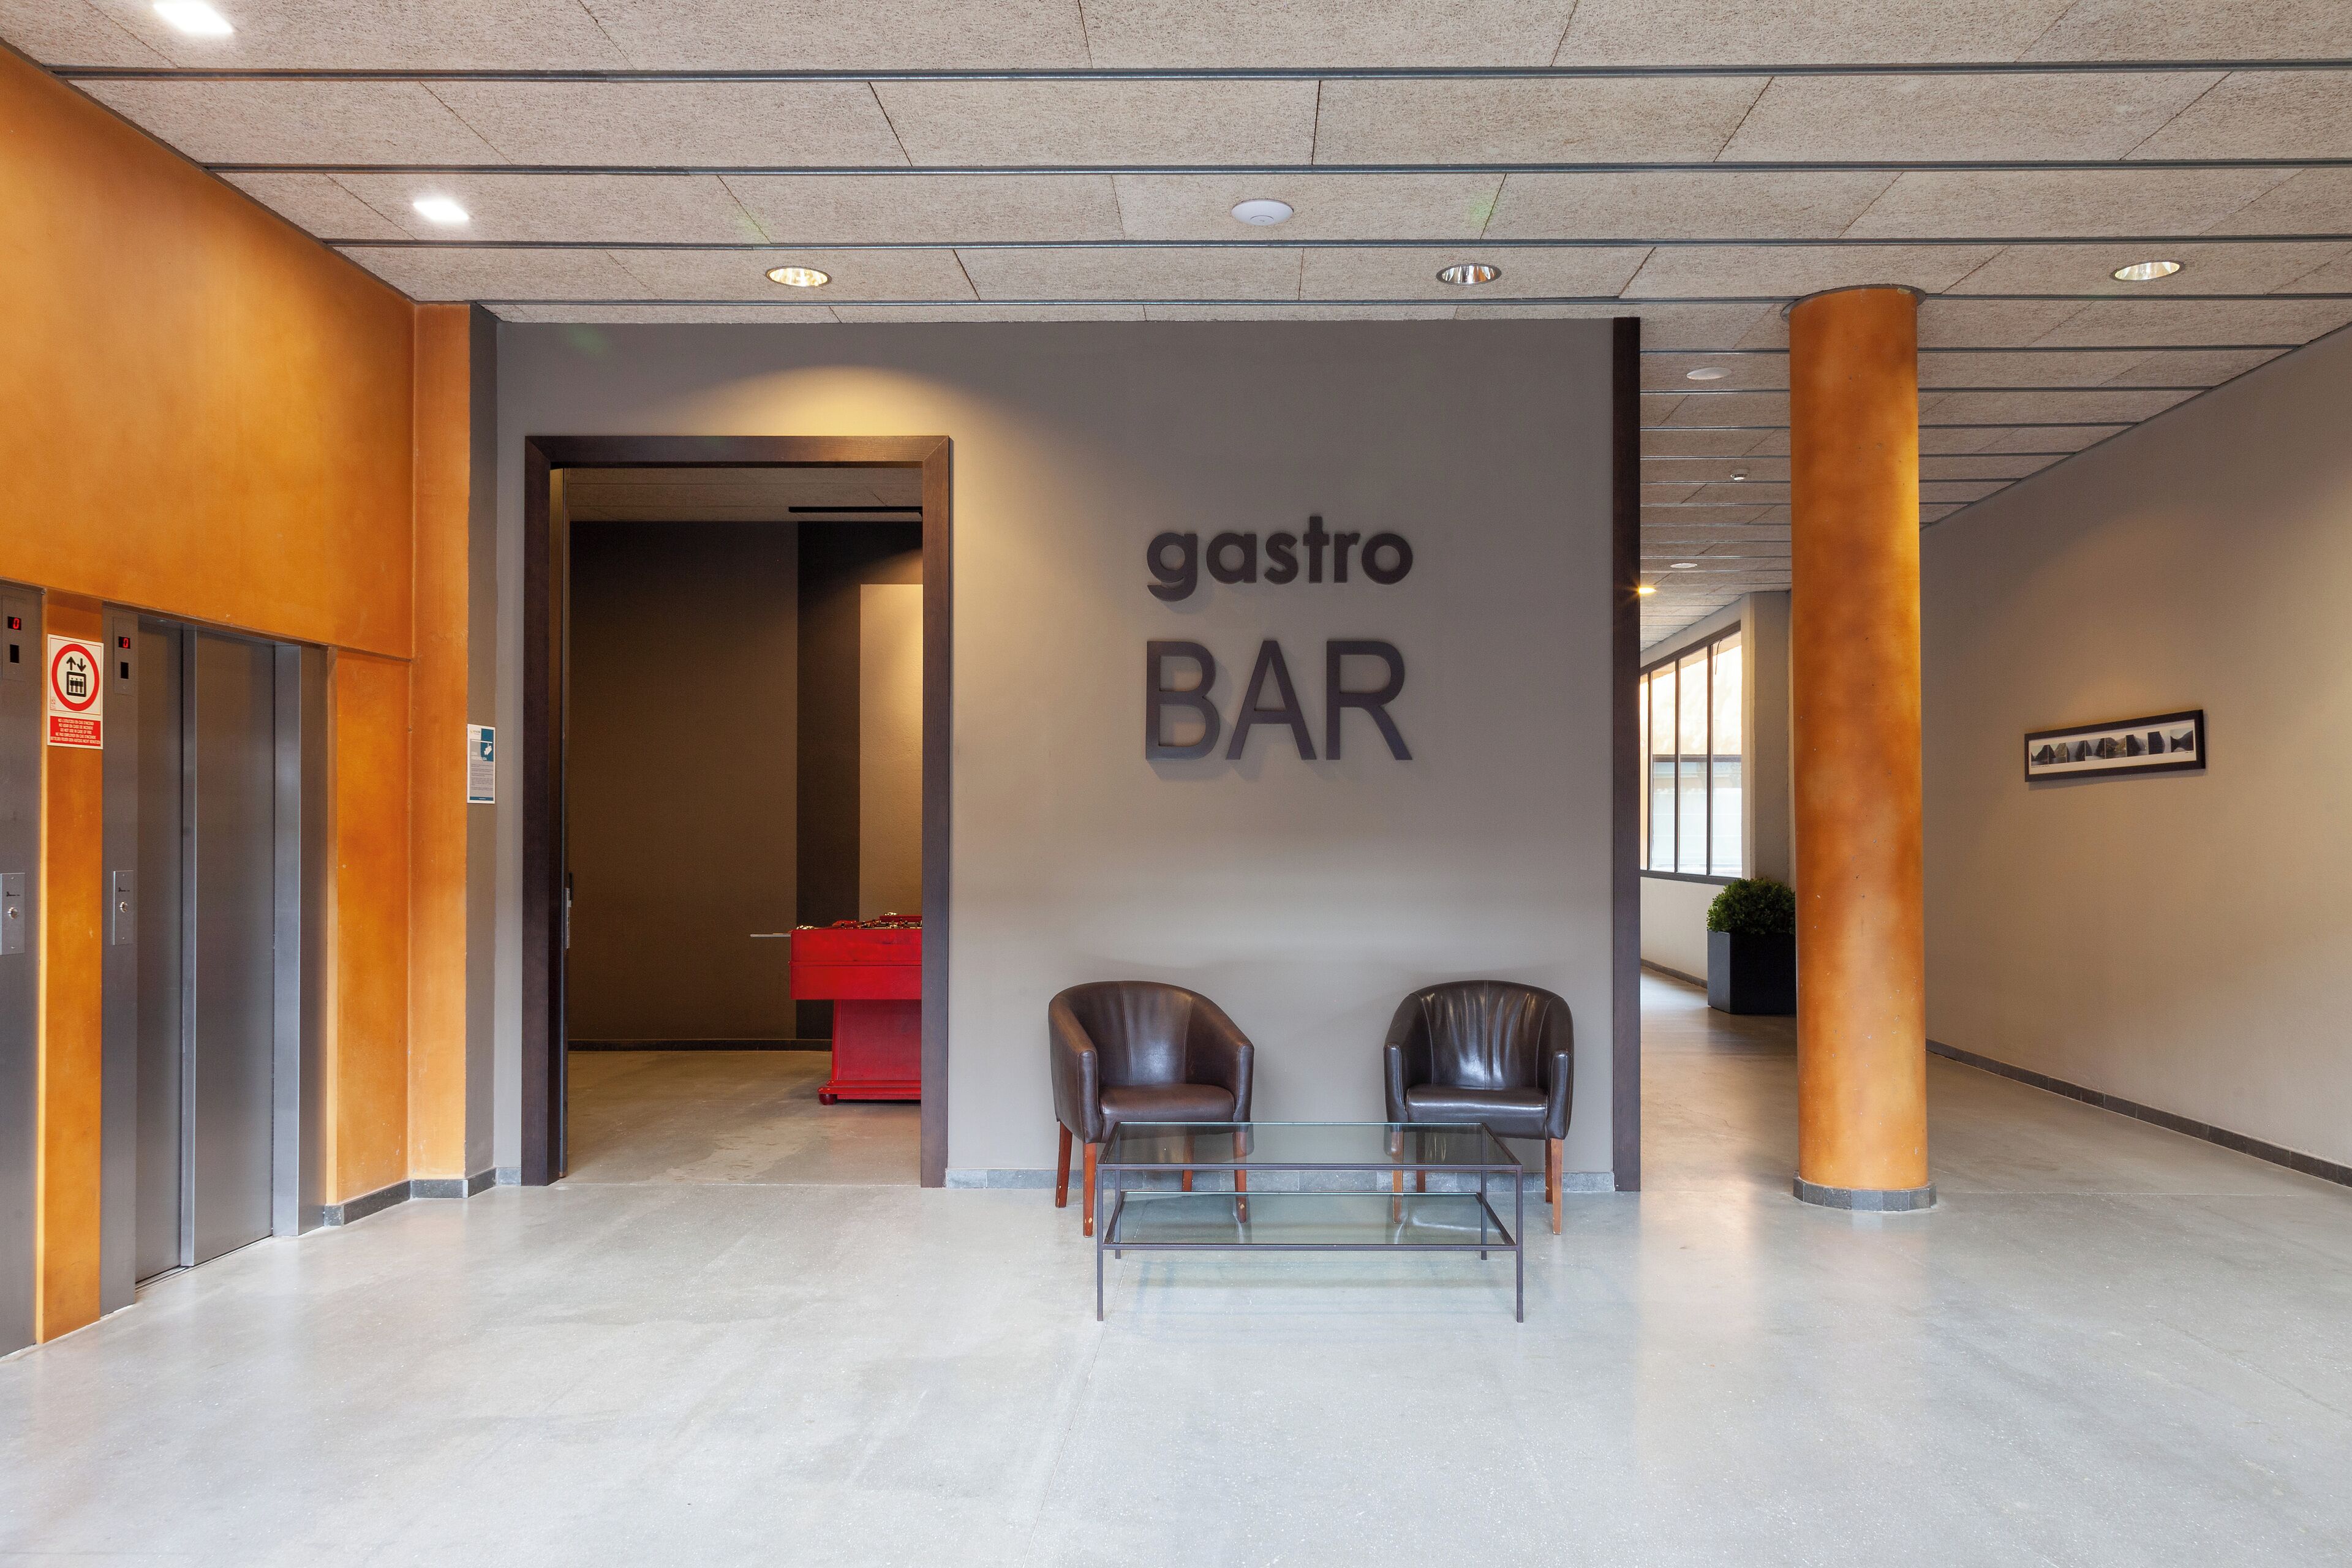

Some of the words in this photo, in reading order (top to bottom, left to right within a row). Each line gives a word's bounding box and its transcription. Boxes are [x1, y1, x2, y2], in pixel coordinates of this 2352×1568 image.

[1147, 515, 1413, 602] gastro
[13, 617, 20, 629] 0
[123, 638, 129, 648] 0
[1145, 640, 1413, 761] BAR
